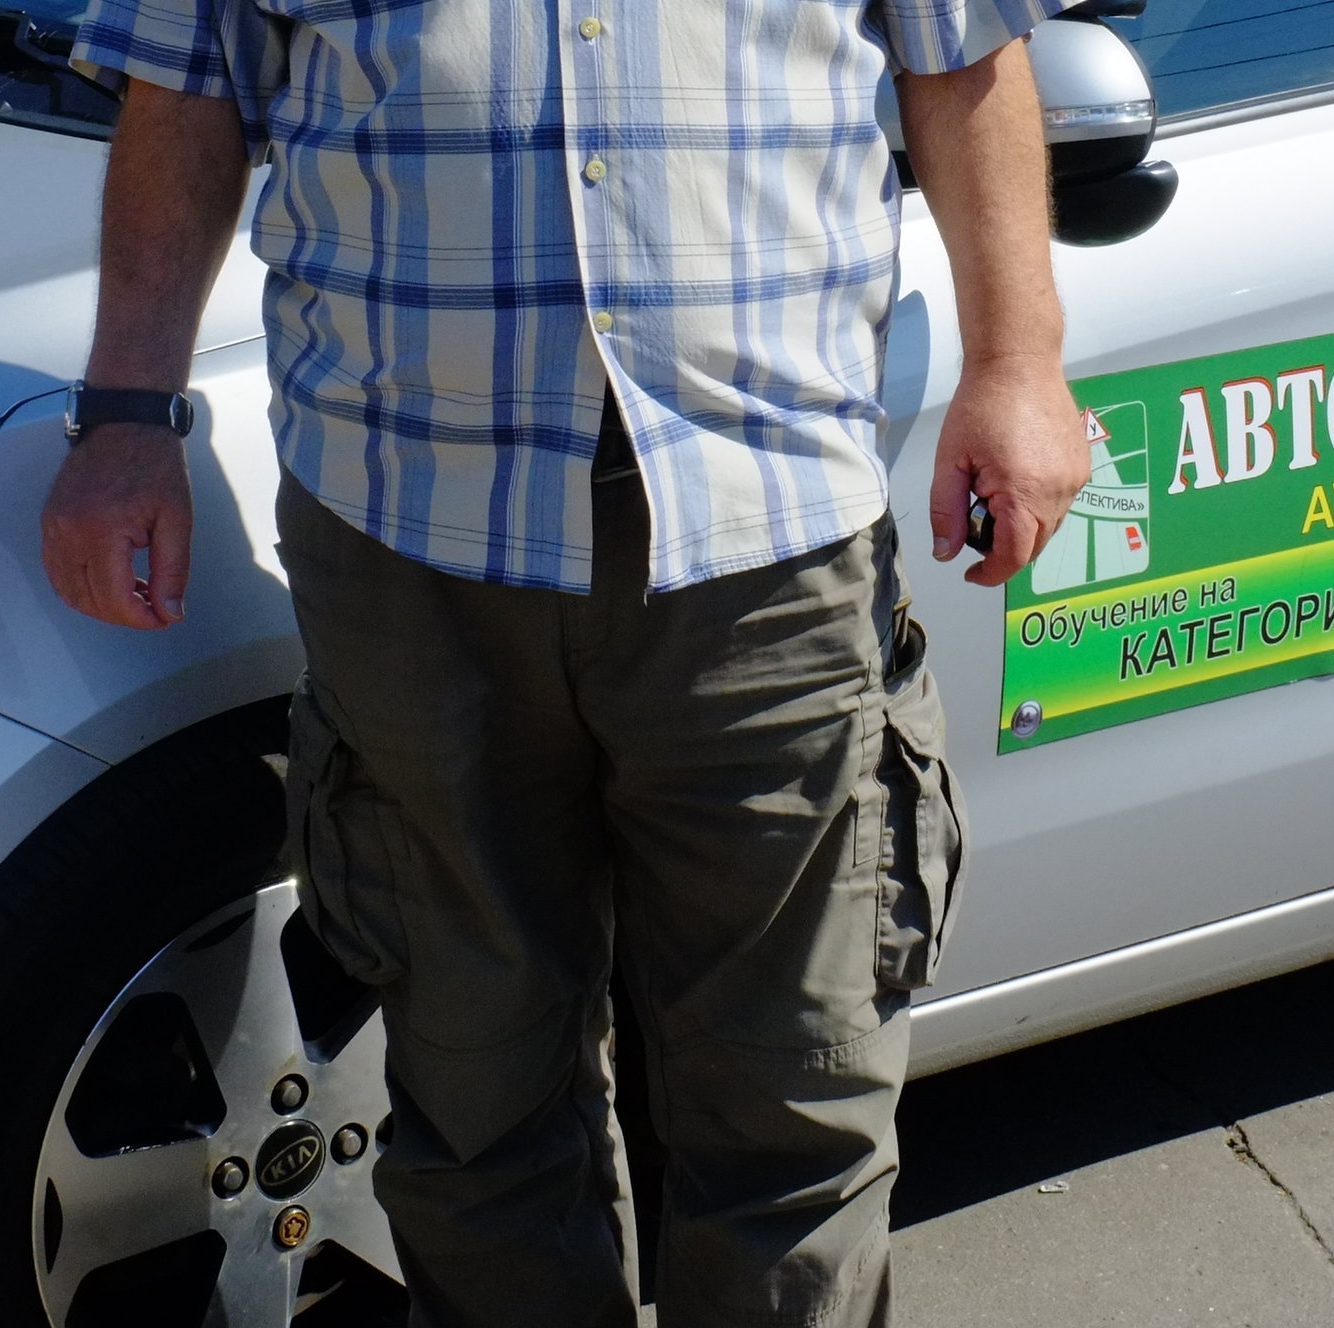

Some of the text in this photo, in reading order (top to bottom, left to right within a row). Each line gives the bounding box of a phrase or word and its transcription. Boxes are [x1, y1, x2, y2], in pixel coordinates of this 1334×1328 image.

[1020, 576, 1237, 649] Обучение на
[271, 1145, 312, 1180] KIA
